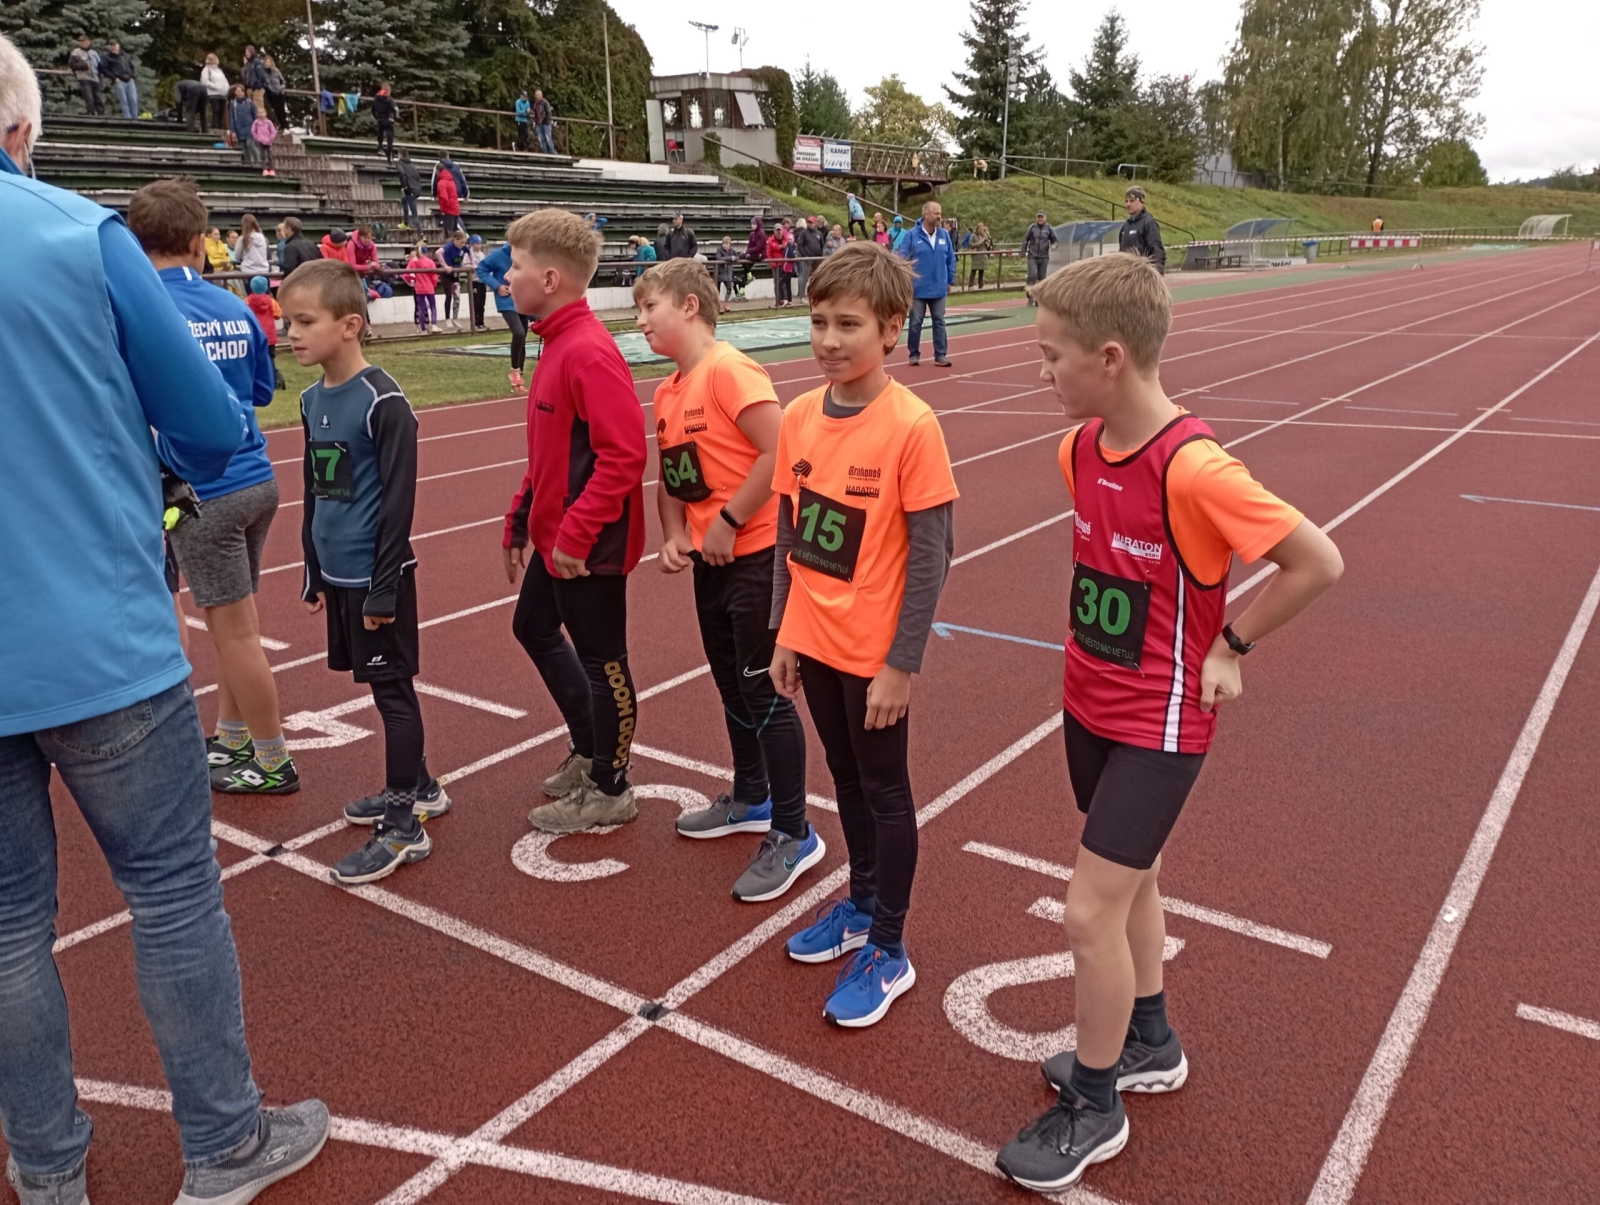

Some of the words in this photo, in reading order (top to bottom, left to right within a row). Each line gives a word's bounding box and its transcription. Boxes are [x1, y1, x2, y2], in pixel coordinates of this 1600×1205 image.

[830, 147, 850, 155] KAMAT
[663, 451, 697, 488] 64
[845, 485, 880, 496] MARATON
[801, 502, 847, 552] 15
[1111, 532, 1162, 553] MARATON
[819, 558, 830, 568] NAD
[1077, 578, 1131, 635] 30
[1100, 643, 1112, 655] NAD
[604, 661, 633, 717] MOOD
[613, 717, 634, 769] GOOD
